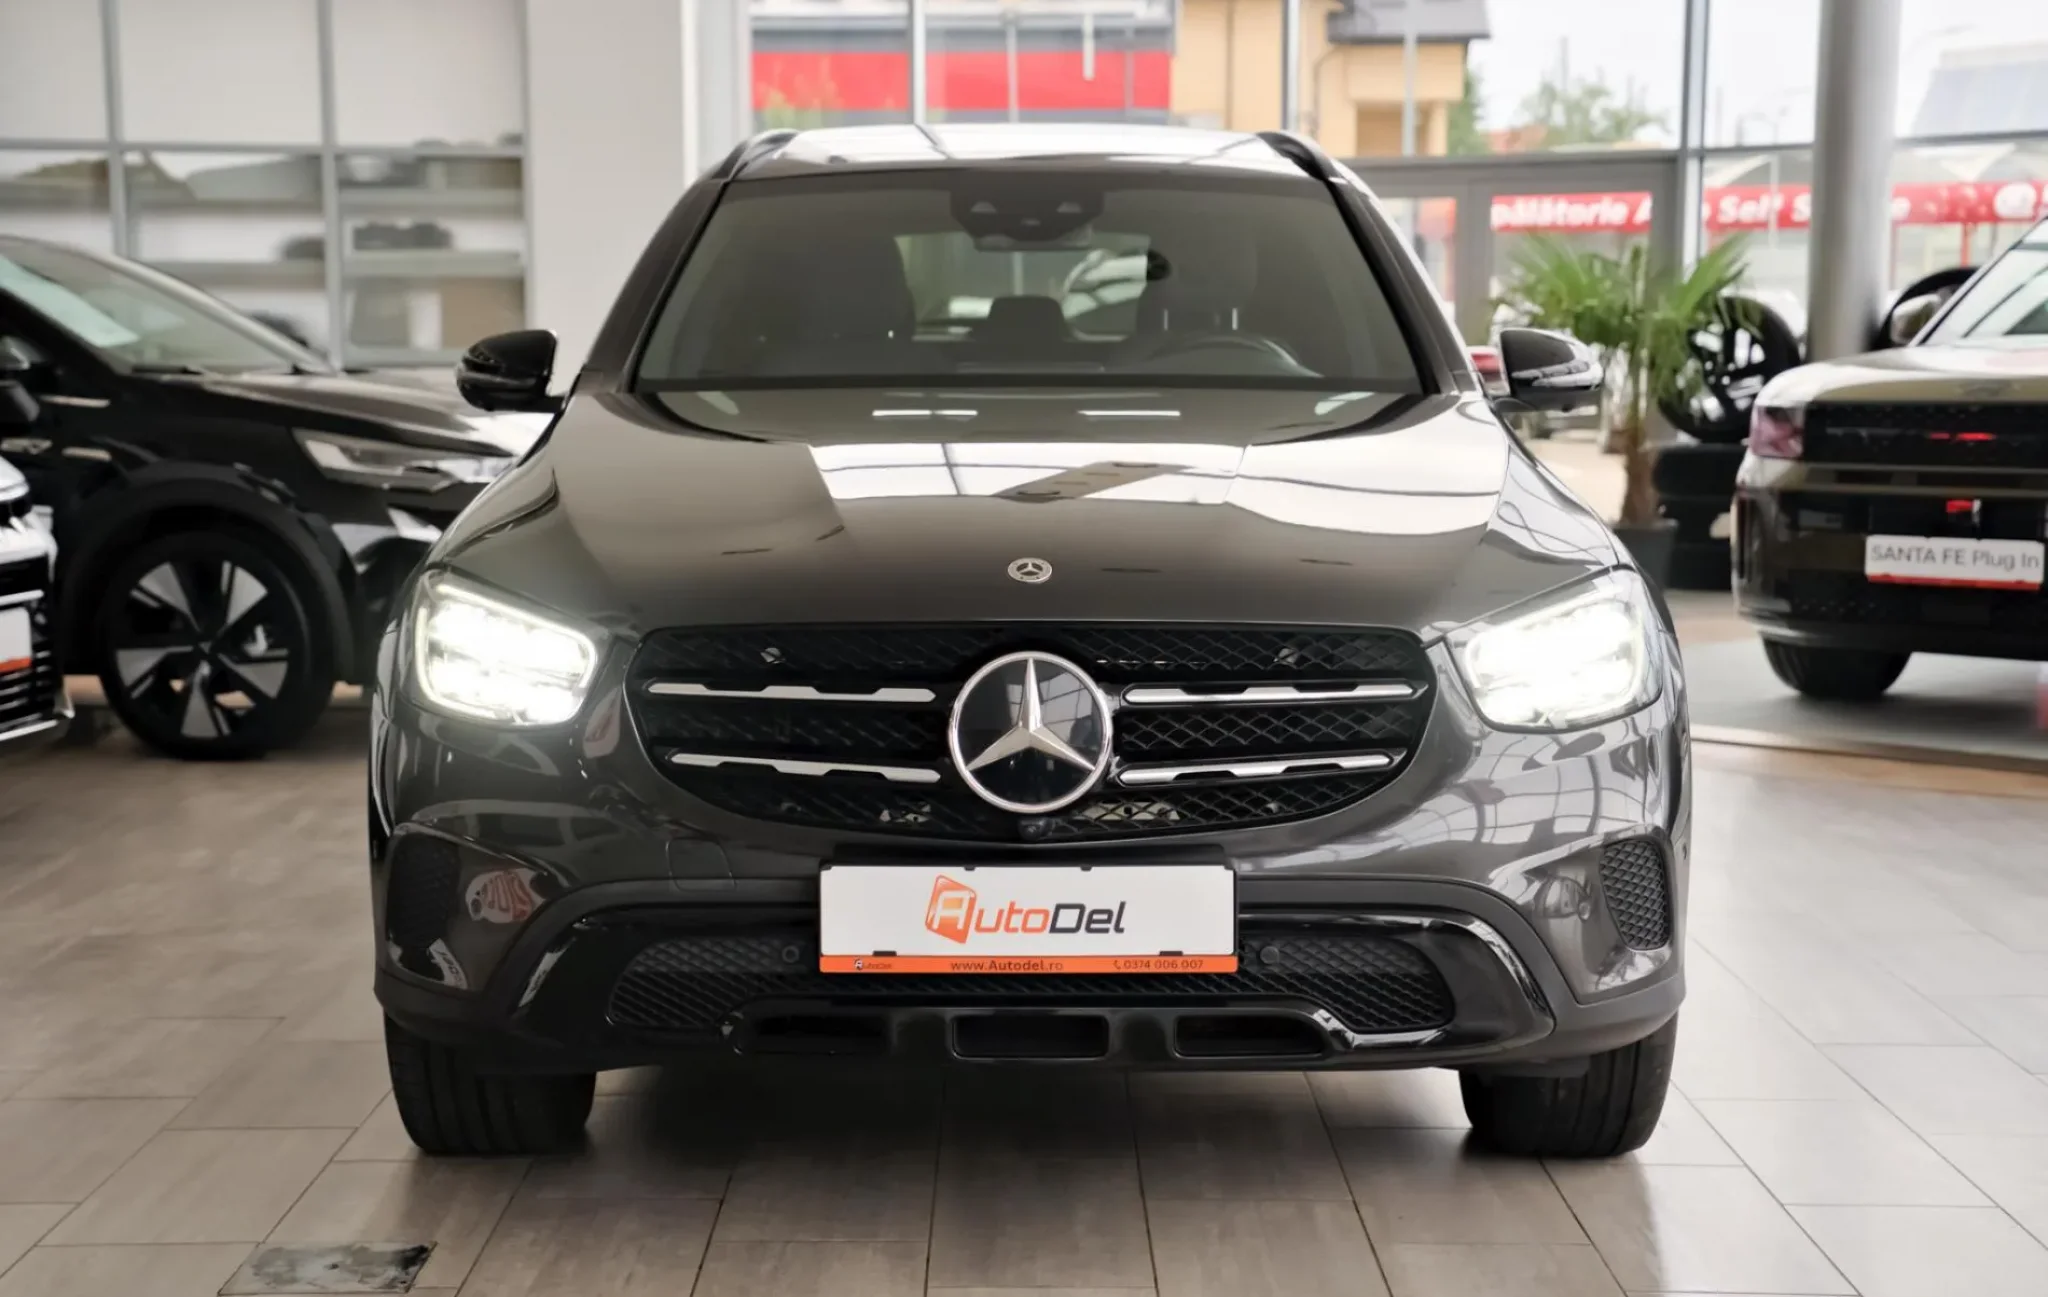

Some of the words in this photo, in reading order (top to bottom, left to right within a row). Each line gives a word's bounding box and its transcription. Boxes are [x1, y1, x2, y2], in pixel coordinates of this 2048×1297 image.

[1872, 544, 1937, 563] SANTA
[1943, 548, 1966, 566] FE
[1973, 550, 2016, 572] Plug
[2021, 553, 2040, 569] In
[931, 888, 1126, 935] AutoDel
[951, 959, 1064, 971] www.Autodel.ro
[1123, 959, 1151, 970] 0374
[1154, 959, 1179, 970] 006
[1181, 959, 1204, 970] 007
